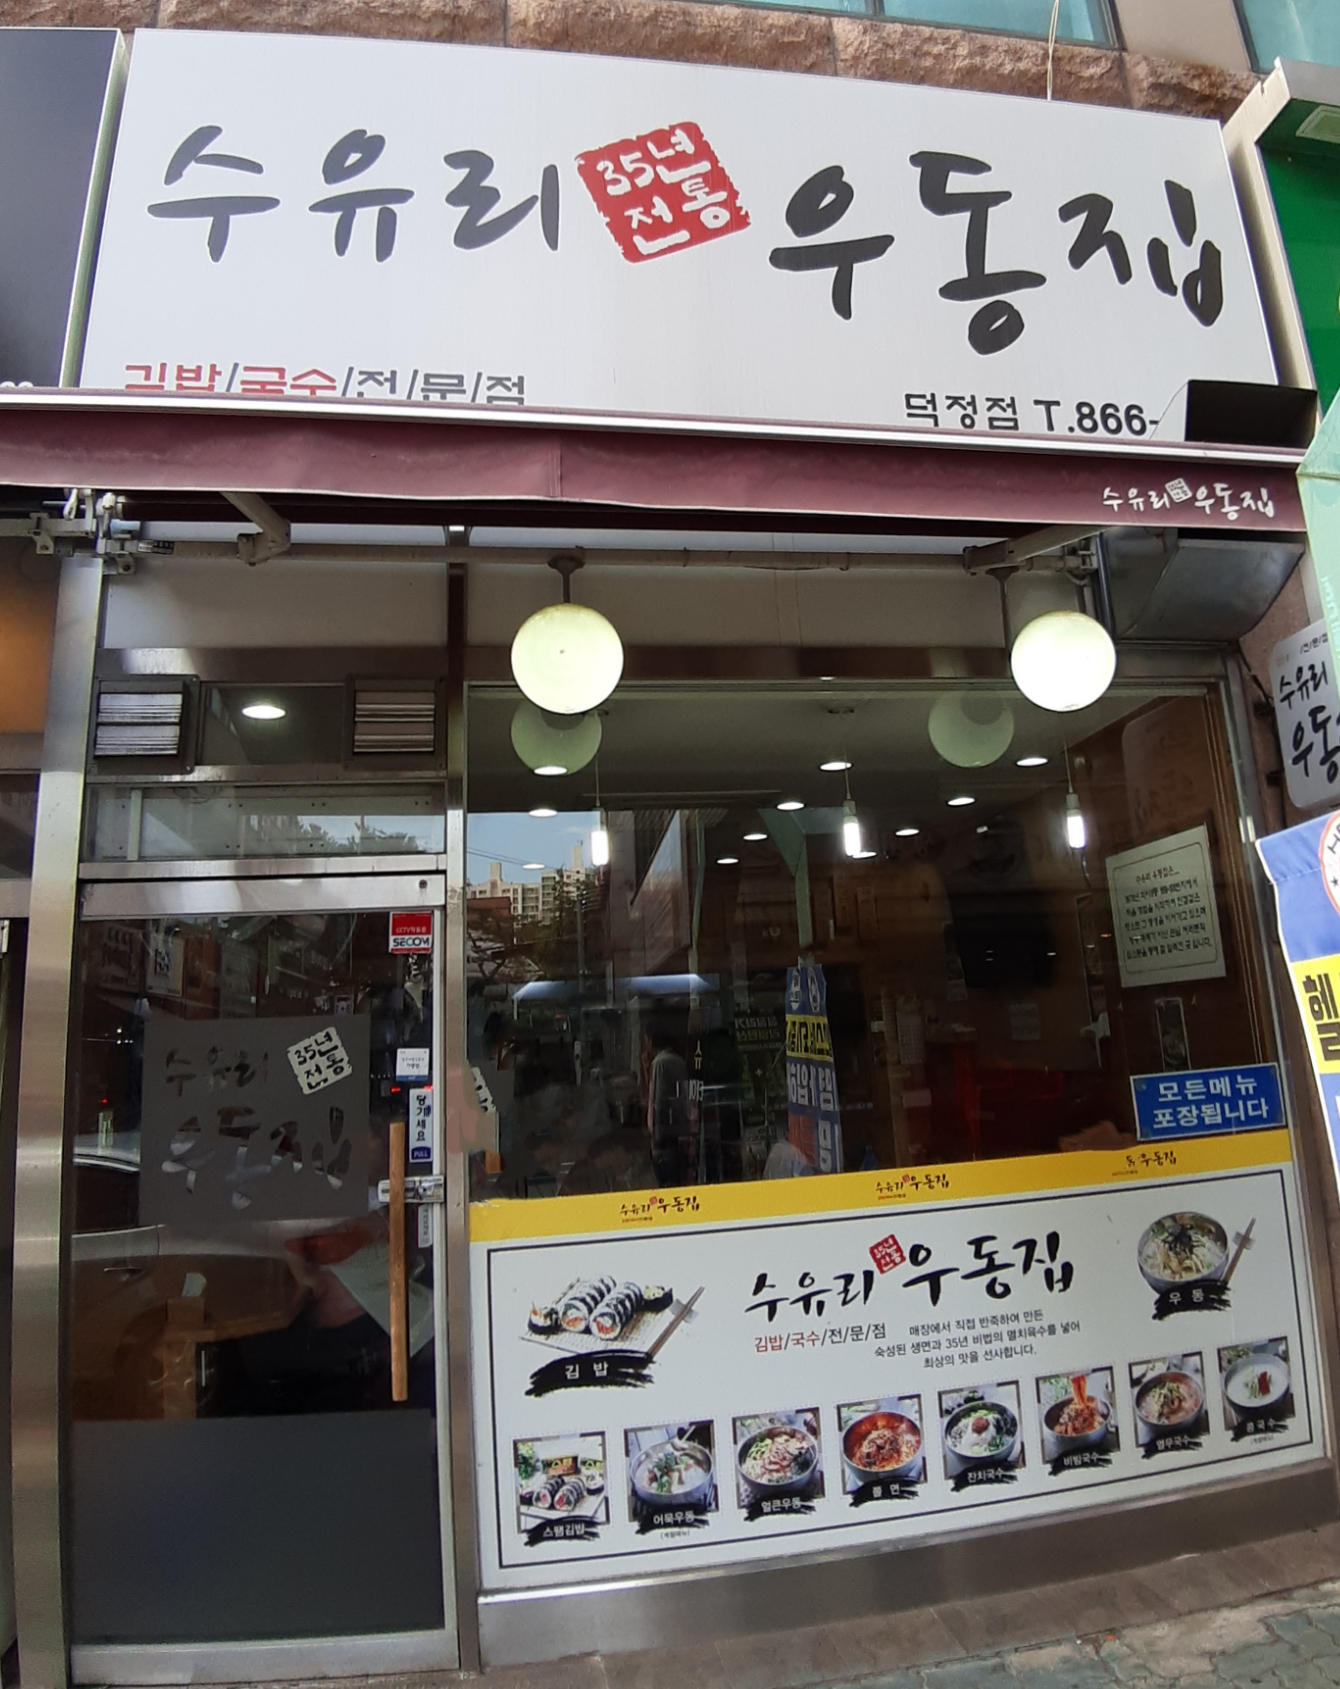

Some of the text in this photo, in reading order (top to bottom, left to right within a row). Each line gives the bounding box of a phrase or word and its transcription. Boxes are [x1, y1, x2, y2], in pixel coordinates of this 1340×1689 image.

[596, 128, 711, 196] 35년
[147, 125, 559, 263] 수유리
[624, 178, 731, 256] 전통
[769, 151, 1223, 355] 우동집
[904, 392, 1019, 431] 덕정점
[1103, 486, 1170, 513] 수유리
[1194, 483, 1275, 521] 우동집
[1280, 661, 1328, 710] 수유리
[393, 937, 430, 947] SECOM
[294, 1031, 339, 1066] 35년
[304, 1053, 345, 1091] 전통
[1158, 1074, 1257, 1102] 모든메뉴
[416, 1094, 428, 1142] 당기세요
[1153, 1098, 1268, 1128] 포장됩니다
[1141, 1151, 1177, 1167] 우동집
[875, 1181, 904, 1193] 수유리
[909, 1173, 950, 1191] 우동집
[620, 1203, 651, 1217] 수유리
[657, 1195, 700, 1214] 우동집
[902, 1231, 1074, 1307] 우동집
[744, 1270, 874, 1323] 수유리
[909, 1309, 1043, 1337] 매장에서 직접 반죽하여 만든
[874, 1320, 1080, 1358] 숙성된 생면과 35년 비법의 멸치육수를 넣어
[923, 1343, 1037, 1369] 최상의 맛을 선사합니다.
[1063, 1452, 1099, 1467] 비빔국수
[967, 1468, 1003, 1484] 잔치국수
[653, 1511, 696, 1526] 어묵우동
